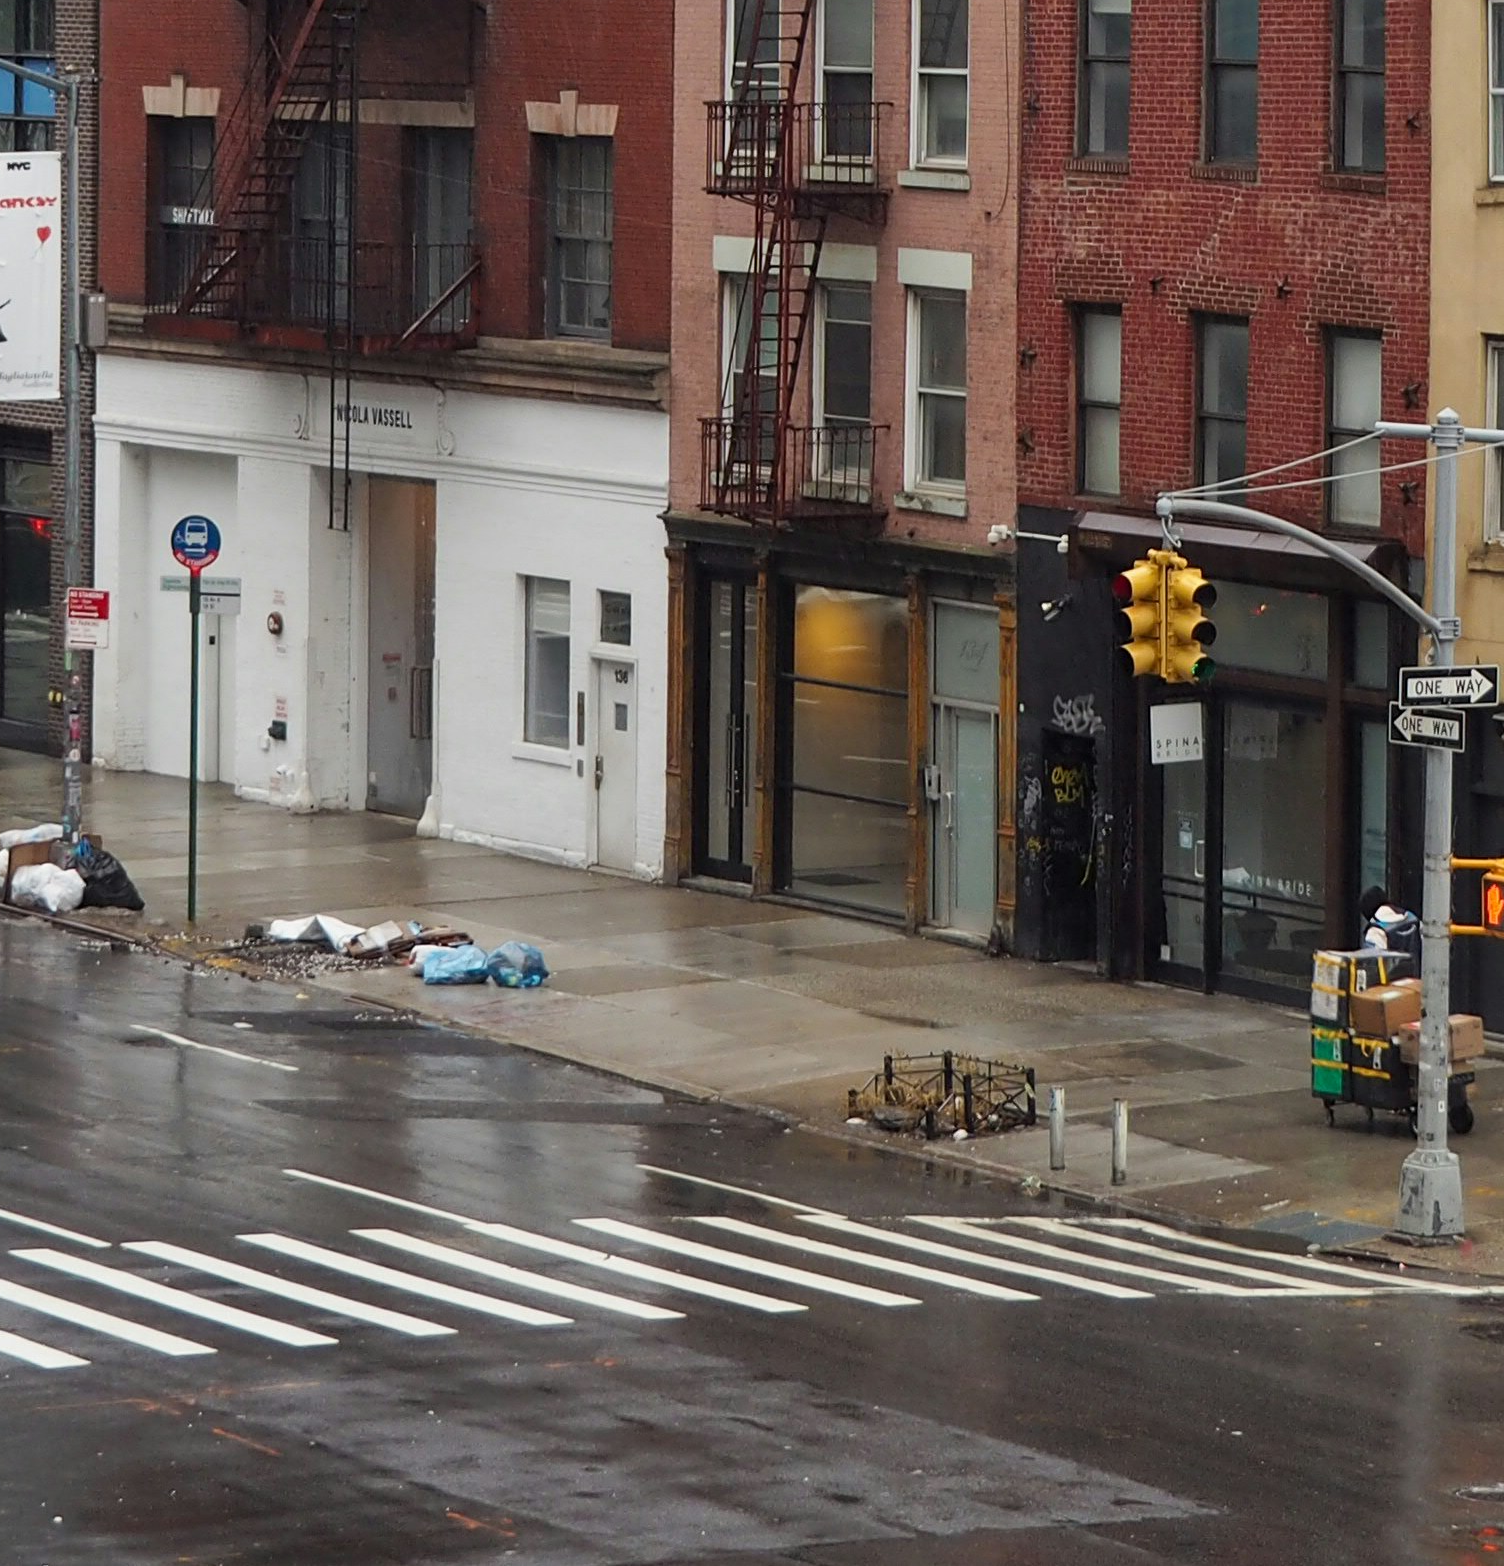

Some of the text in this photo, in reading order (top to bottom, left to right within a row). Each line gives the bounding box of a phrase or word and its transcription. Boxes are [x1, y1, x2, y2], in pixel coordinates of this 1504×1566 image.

[7, 162, 31, 171] NYC
[372, 407, 412, 429] VASSELL
[1415, 679, 1484, 695] ONE WAY
[1402, 717, 1455, 735] ONE WAY
[1156, 736, 1200, 748] SPINA
[1278, 878, 1312, 897] BRIDE
